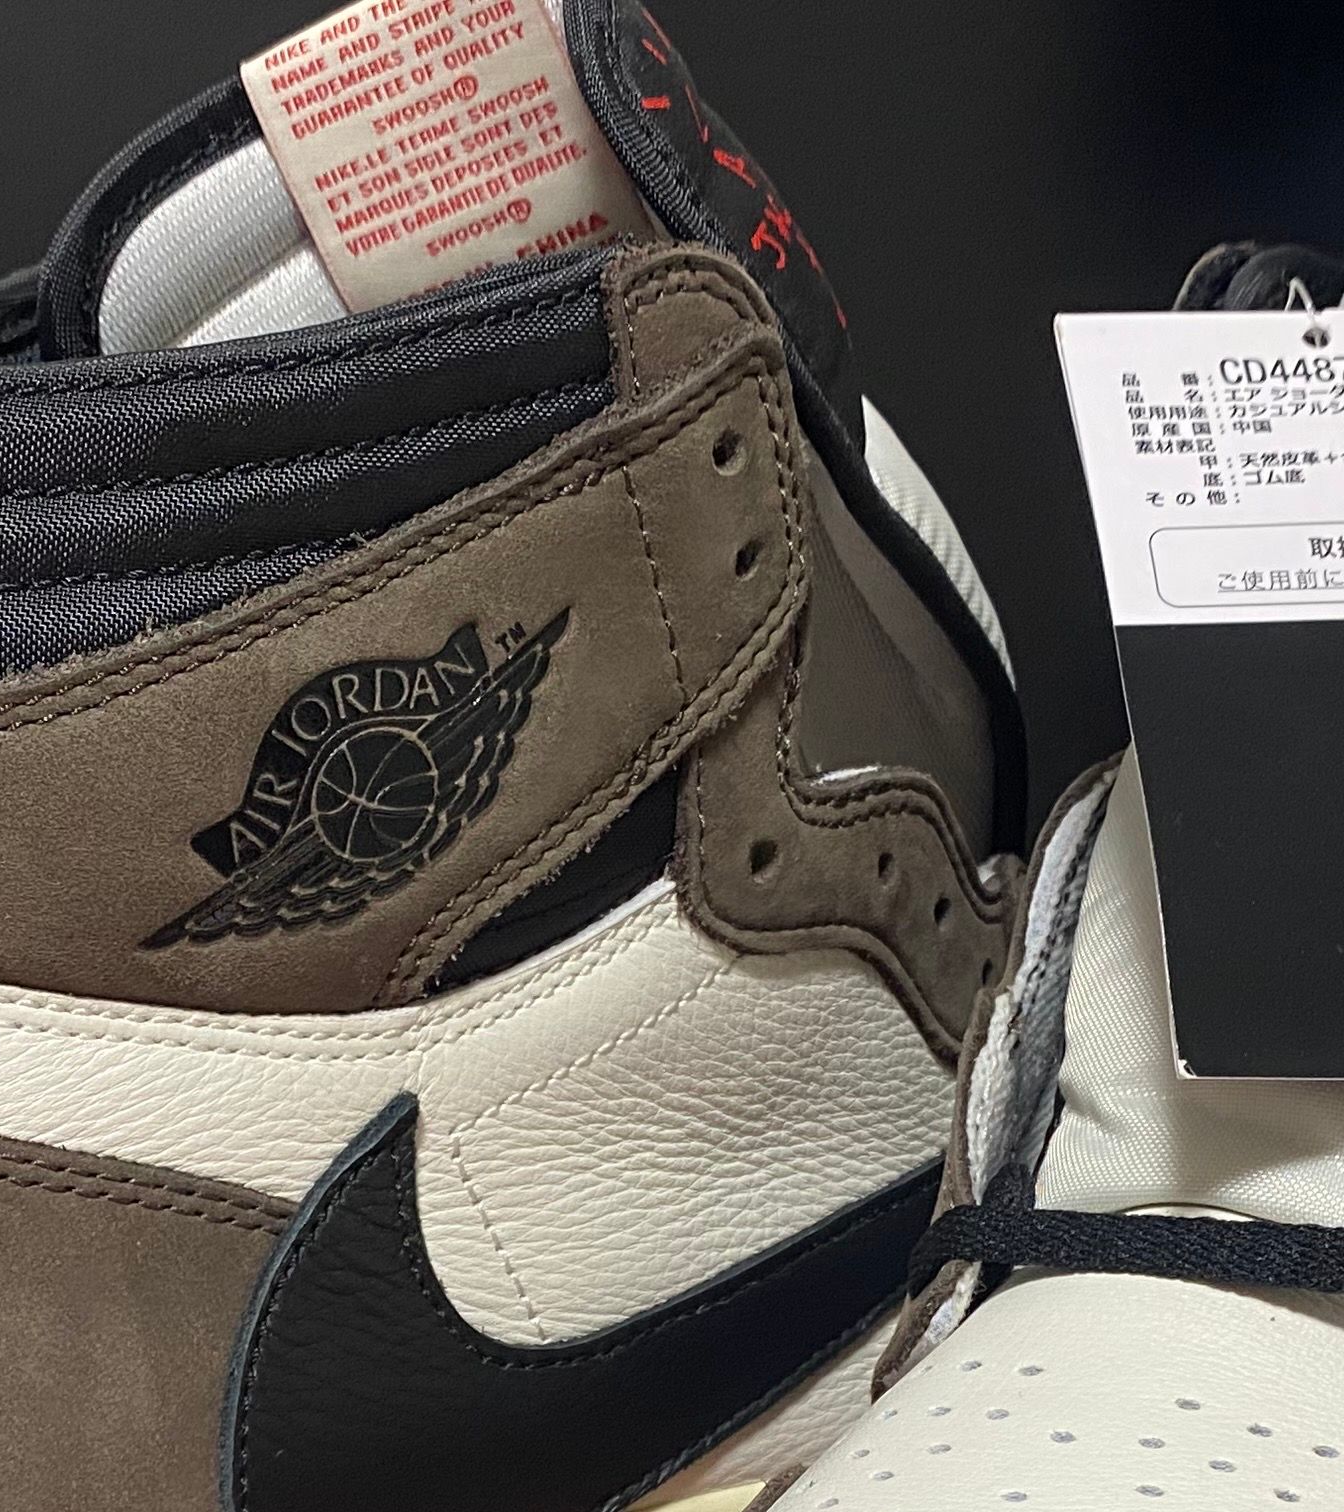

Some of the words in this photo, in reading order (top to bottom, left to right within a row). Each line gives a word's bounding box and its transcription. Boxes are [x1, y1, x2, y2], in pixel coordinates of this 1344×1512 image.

[265, 39, 310, 70] NIKE
[320, 16, 361, 44] AND
[271, 58, 328, 94] NAME
[339, 33, 380, 62] AND
[388, 1, 455, 40] STRIPE
[281, 51, 405, 116] TRADEMARKS
[414, 26, 454, 58] AND
[461, 0, 516, 34] YOUR
[291, 76, 409, 140] GUARANTEE
[411, 61, 435, 86] OF
[444, 22, 524, 70] QUALITY
[327, 190, 352, 214] ET
[358, 168, 401, 197] SON
[405, 147, 455, 178] SIGLE
[461, 120, 513, 153] SONT
[520, 101, 558, 130] DES
[395, 116, 460, 153] TERME
[467, 75, 549, 124] SWOOSH
[335, 183, 429, 234] MARQUES
[538, 126, 562, 147] ET
[345, 224, 401, 258] VOTRE
[402, 183, 485, 233] GARANTIE
[486, 176, 511, 200] DE
[229, 771, 301, 867] AIR
[272, 644, 475, 756] JORDAN
